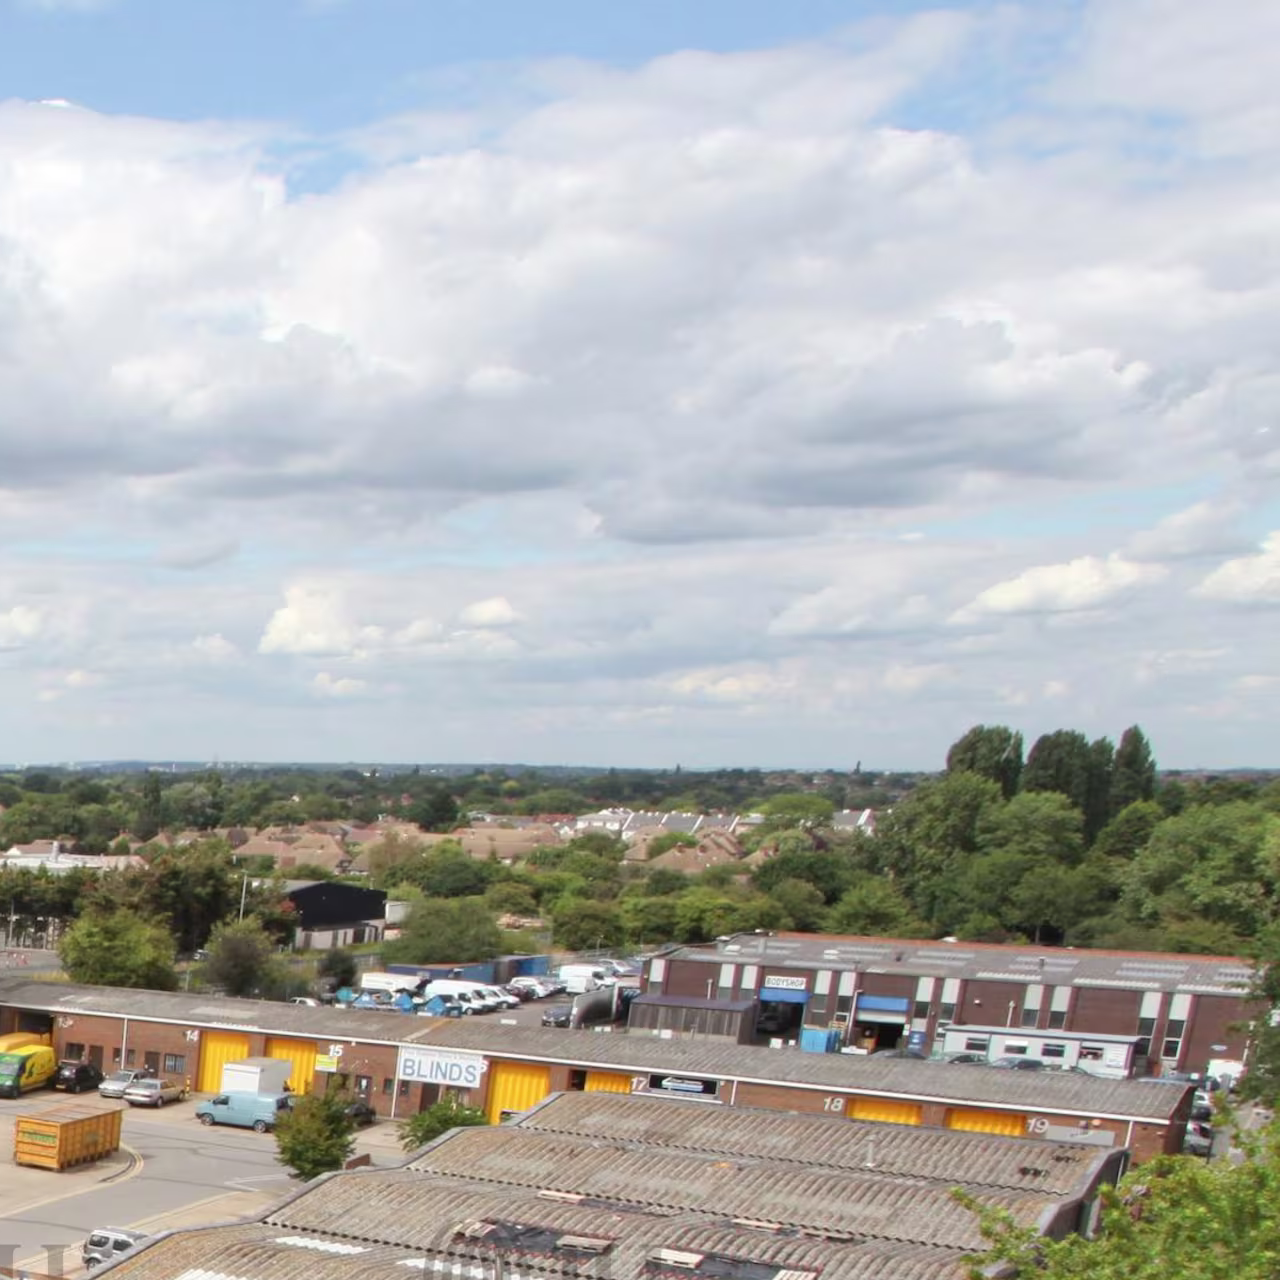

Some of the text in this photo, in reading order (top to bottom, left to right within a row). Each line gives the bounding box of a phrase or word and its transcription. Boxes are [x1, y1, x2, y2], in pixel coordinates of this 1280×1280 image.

[185, 1029, 200, 1042] 14
[328, 1044, 344, 1057] 15
[402, 1058, 478, 1084] BLINDS
[631, 1076, 648, 1090] 17
[824, 1096, 844, 1112] 18
[1027, 1117, 1049, 1133] 19
